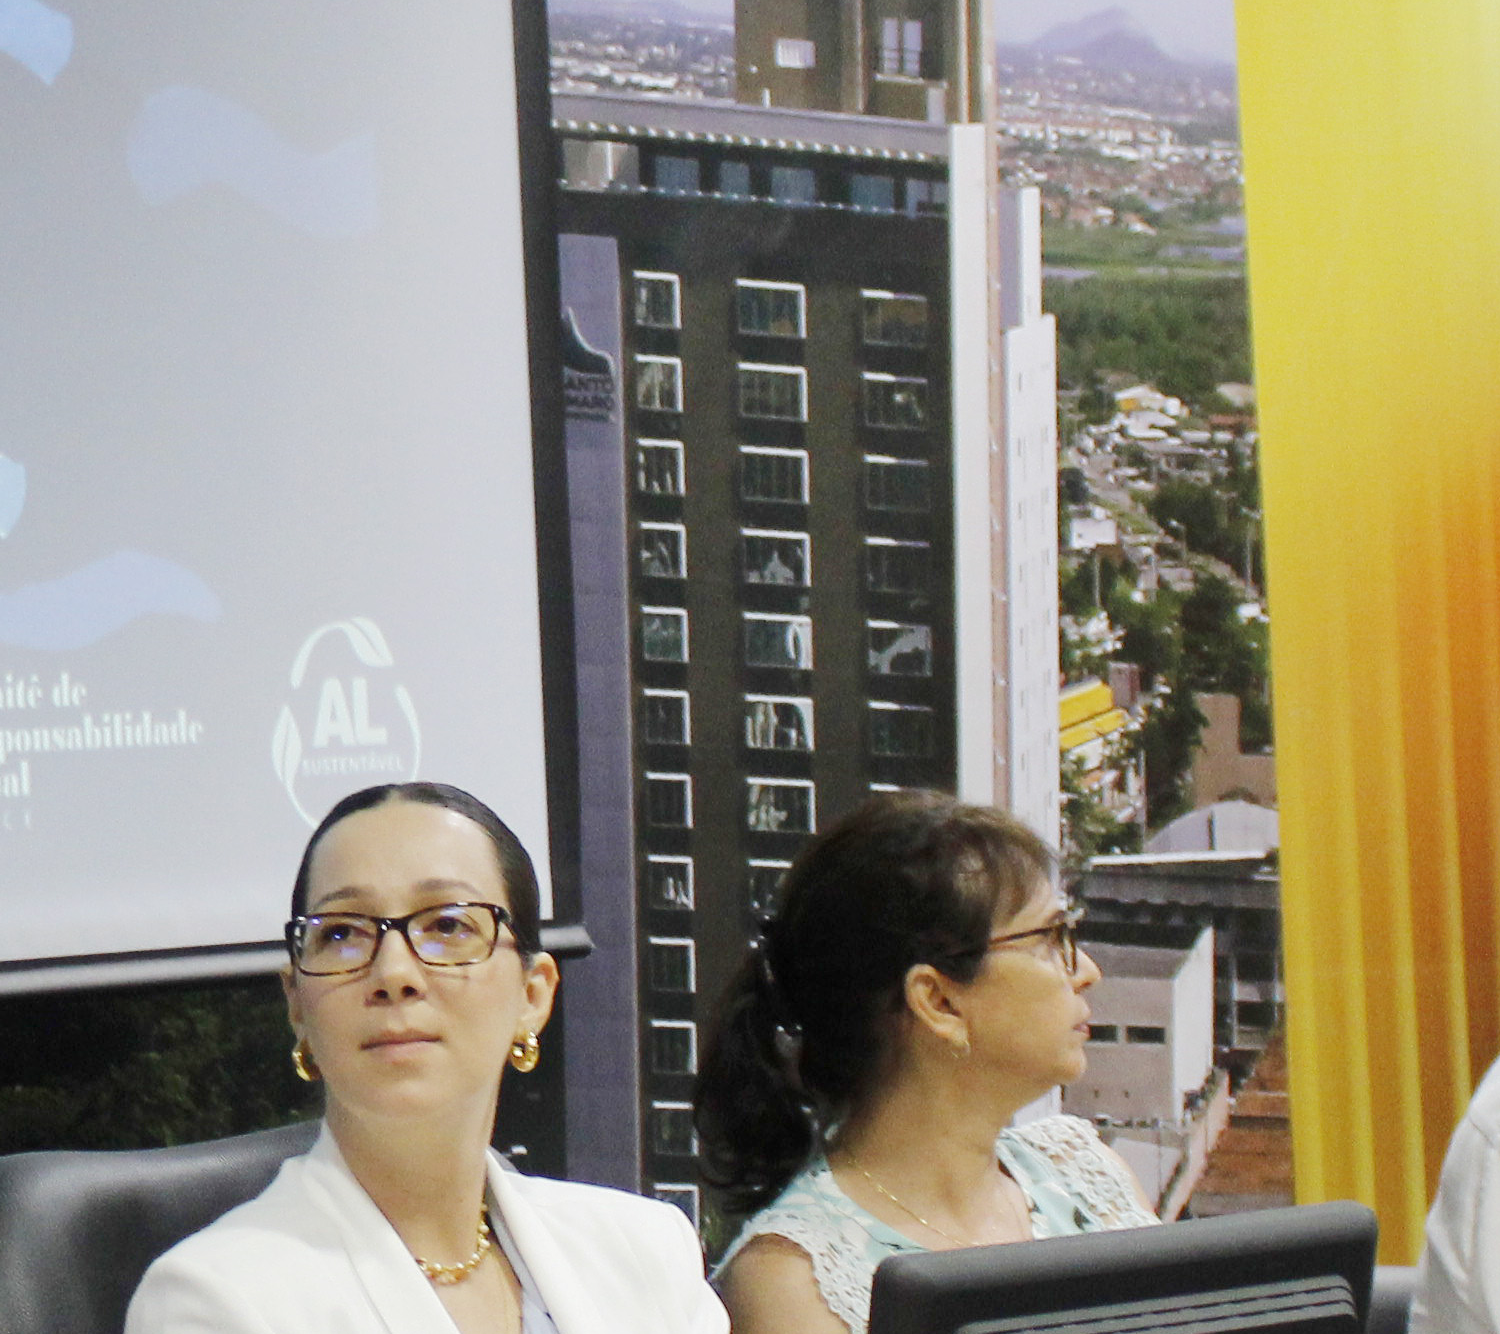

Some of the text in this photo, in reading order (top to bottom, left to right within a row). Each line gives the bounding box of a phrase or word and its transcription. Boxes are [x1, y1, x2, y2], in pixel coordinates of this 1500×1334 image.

[52, 670, 87, 707] de
[312, 677, 388, 748] AL
[301, 750, 404, 778] SUSTENTÁVEL
